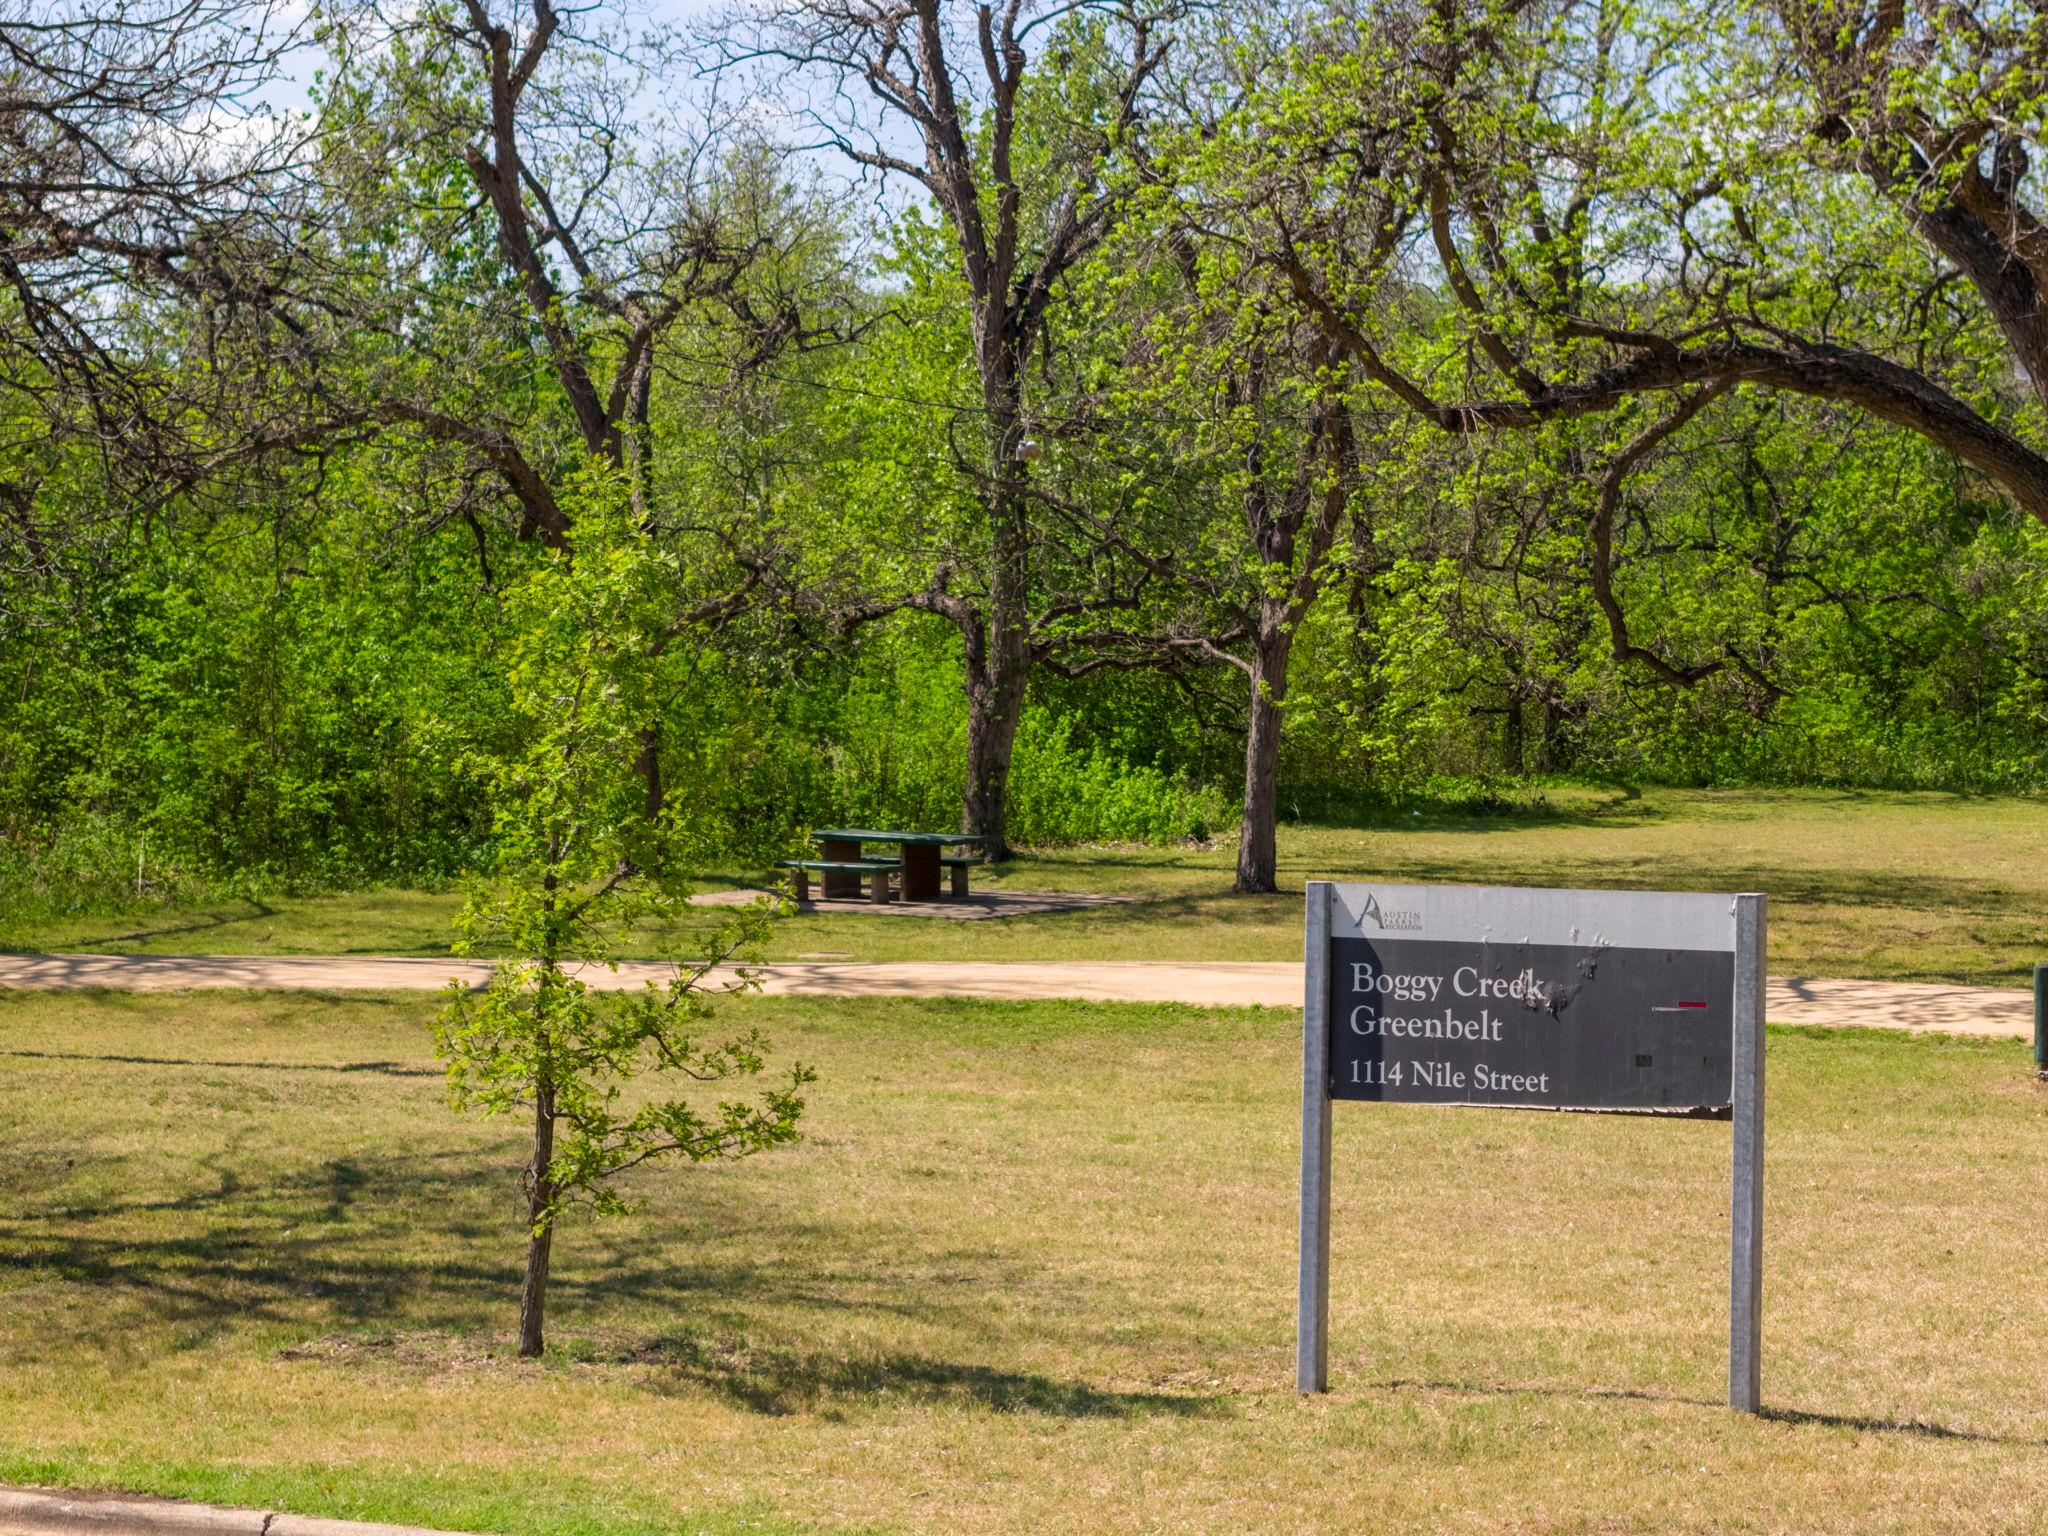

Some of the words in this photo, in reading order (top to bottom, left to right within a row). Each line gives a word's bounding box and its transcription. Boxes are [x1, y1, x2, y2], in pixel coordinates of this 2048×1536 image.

[1383, 911, 1421, 919] AUSTIN
[1350, 963, 1443, 1001] Boggy
[1453, 967, 1545, 999] Creek
[1350, 1006, 1503, 1041] Greenbelt
[1350, 1060, 1403, 1086] 1114
[1412, 1062, 1466, 1088] Nile
[1474, 1064, 1550, 1092] Street
